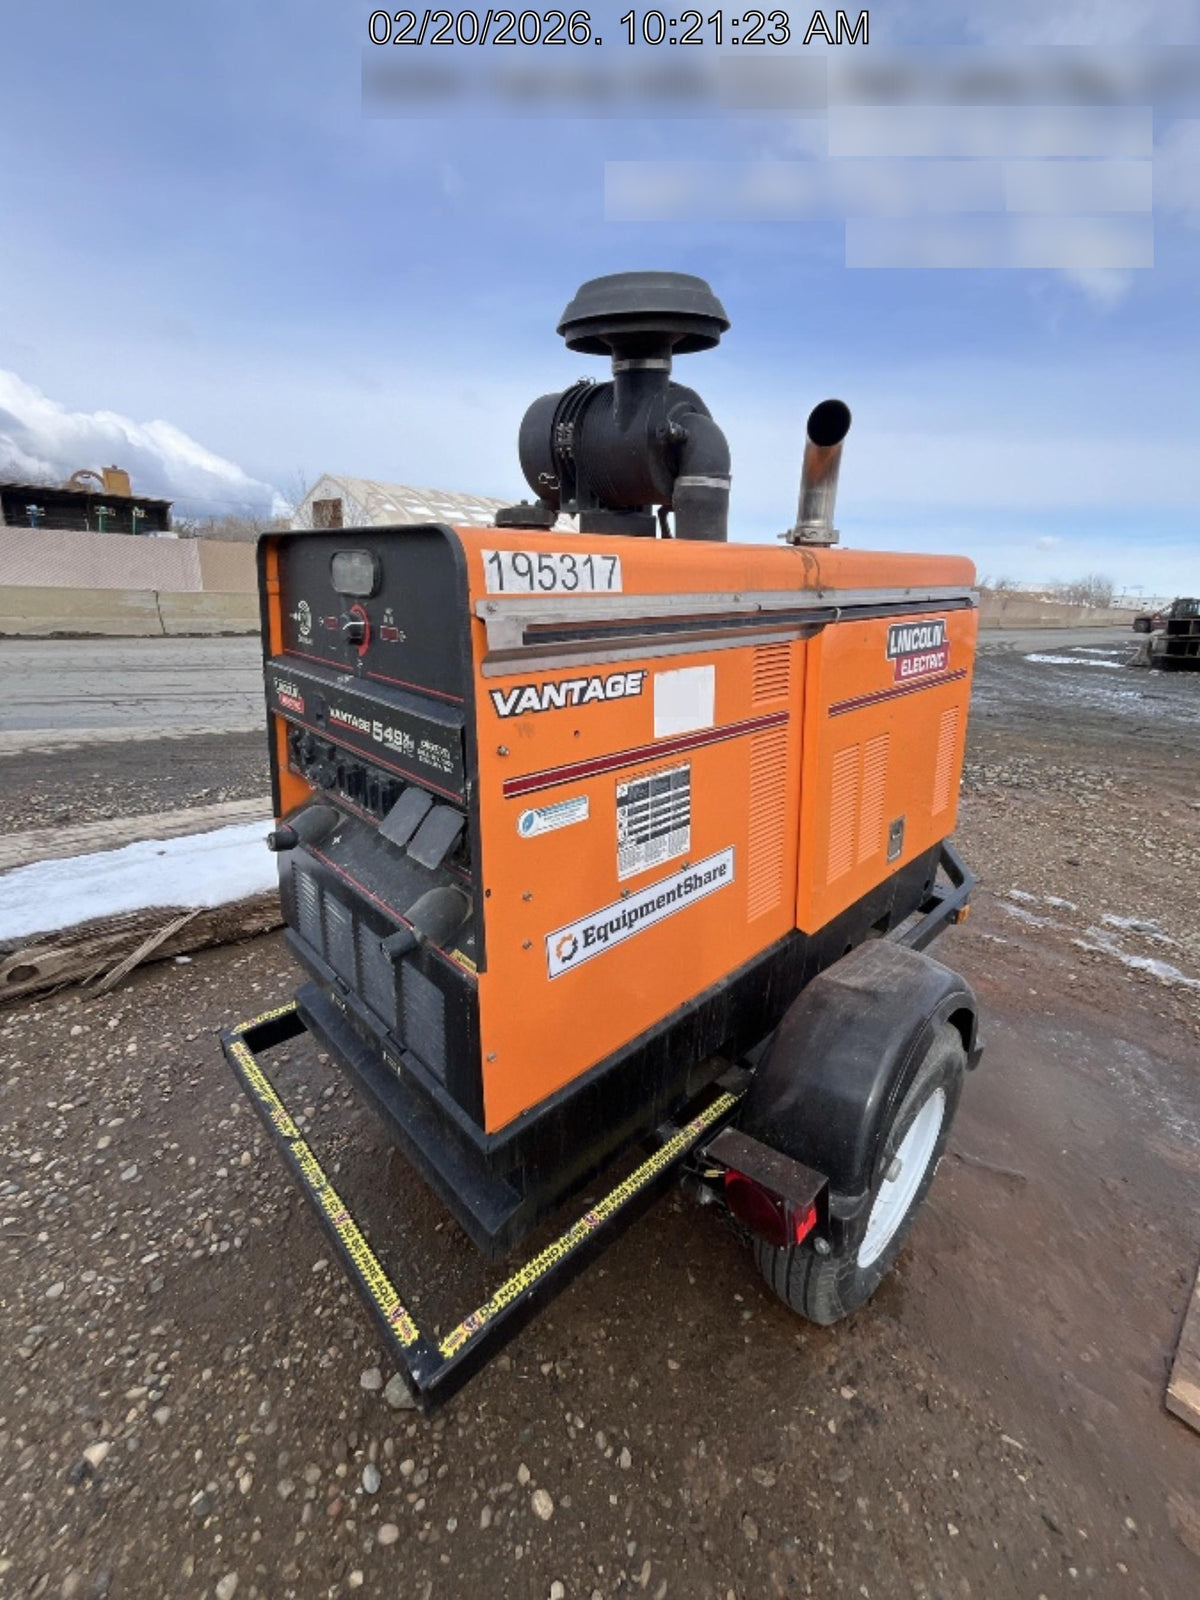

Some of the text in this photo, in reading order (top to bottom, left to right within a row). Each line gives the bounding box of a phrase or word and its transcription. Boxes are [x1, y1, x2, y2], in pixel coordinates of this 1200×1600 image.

[489, 551, 617, 591] 195317
[890, 625, 942, 654] LINCOLN
[901, 652, 944, 676] ELECTRIC
[489, 670, 645, 718] VANTAGE
[582, 862, 727, 948] EquipmentShare
[341, 1222, 355, 1239] NO
[358, 1251, 379, 1280] PARE
[477, 1297, 499, 1318] DO
[498, 1277, 523, 1301] NOT
[523, 1246, 560, 1280] STAND
